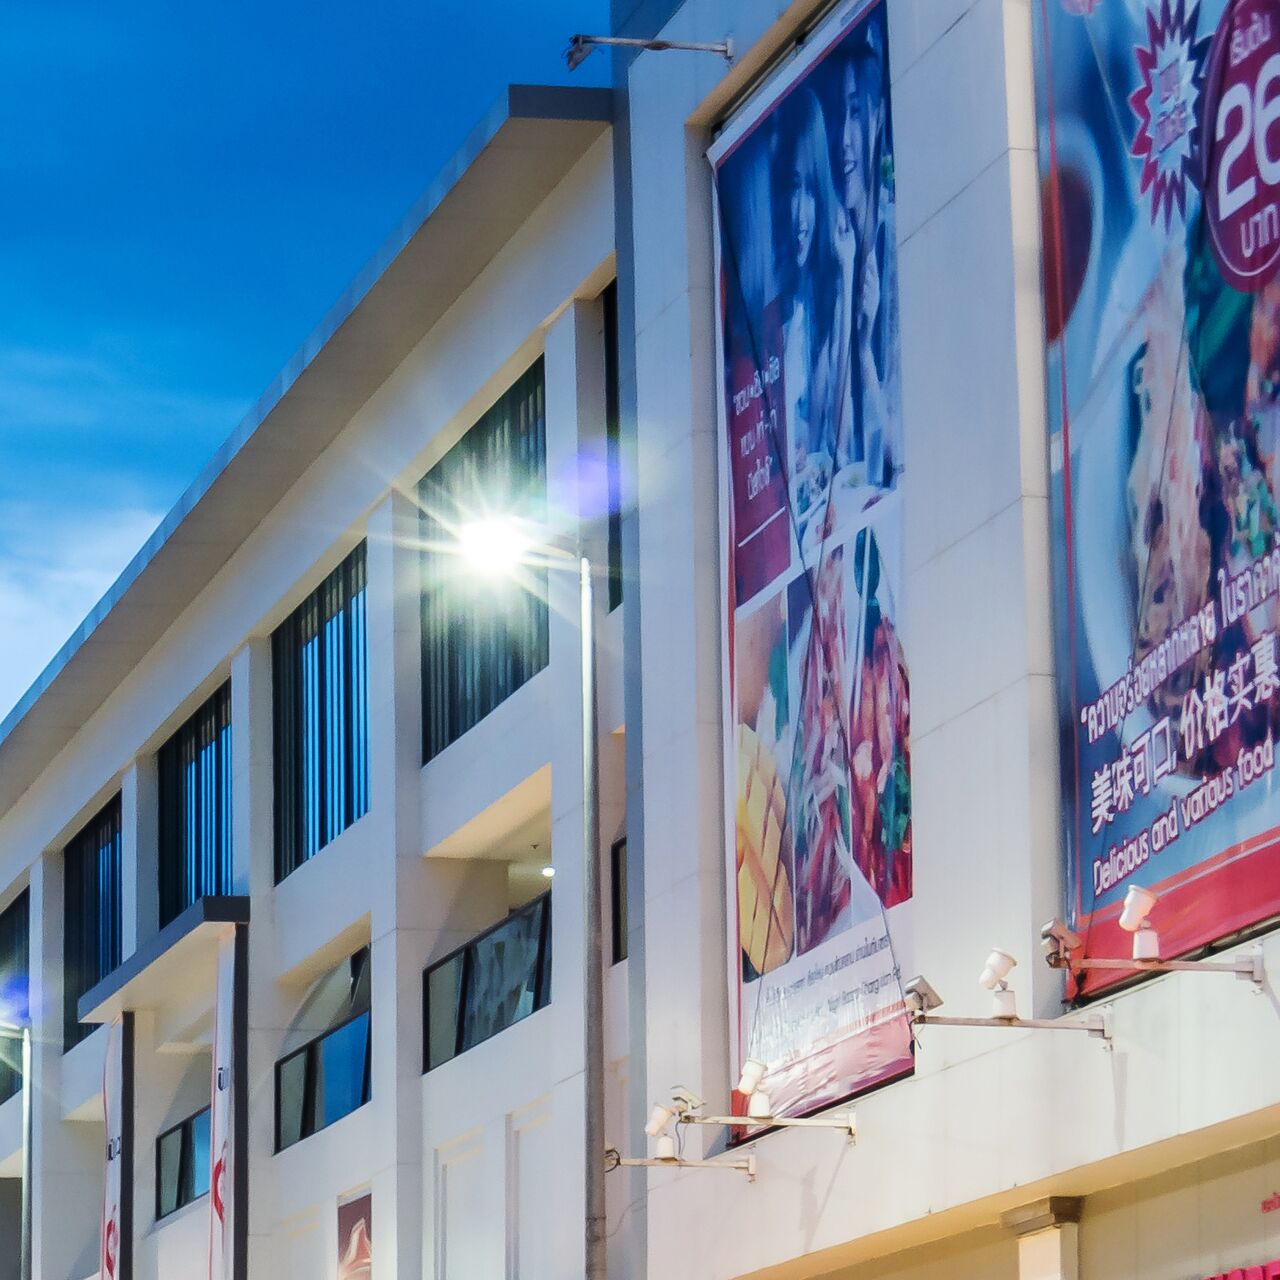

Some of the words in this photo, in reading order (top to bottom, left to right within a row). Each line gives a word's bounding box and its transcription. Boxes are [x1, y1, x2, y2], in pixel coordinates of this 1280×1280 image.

[1093, 831, 1149, 896] Delicious
[1151, 798, 1180, 852] and
[1181, 766, 1234, 832] various
[1237, 728, 1275, 792] food
